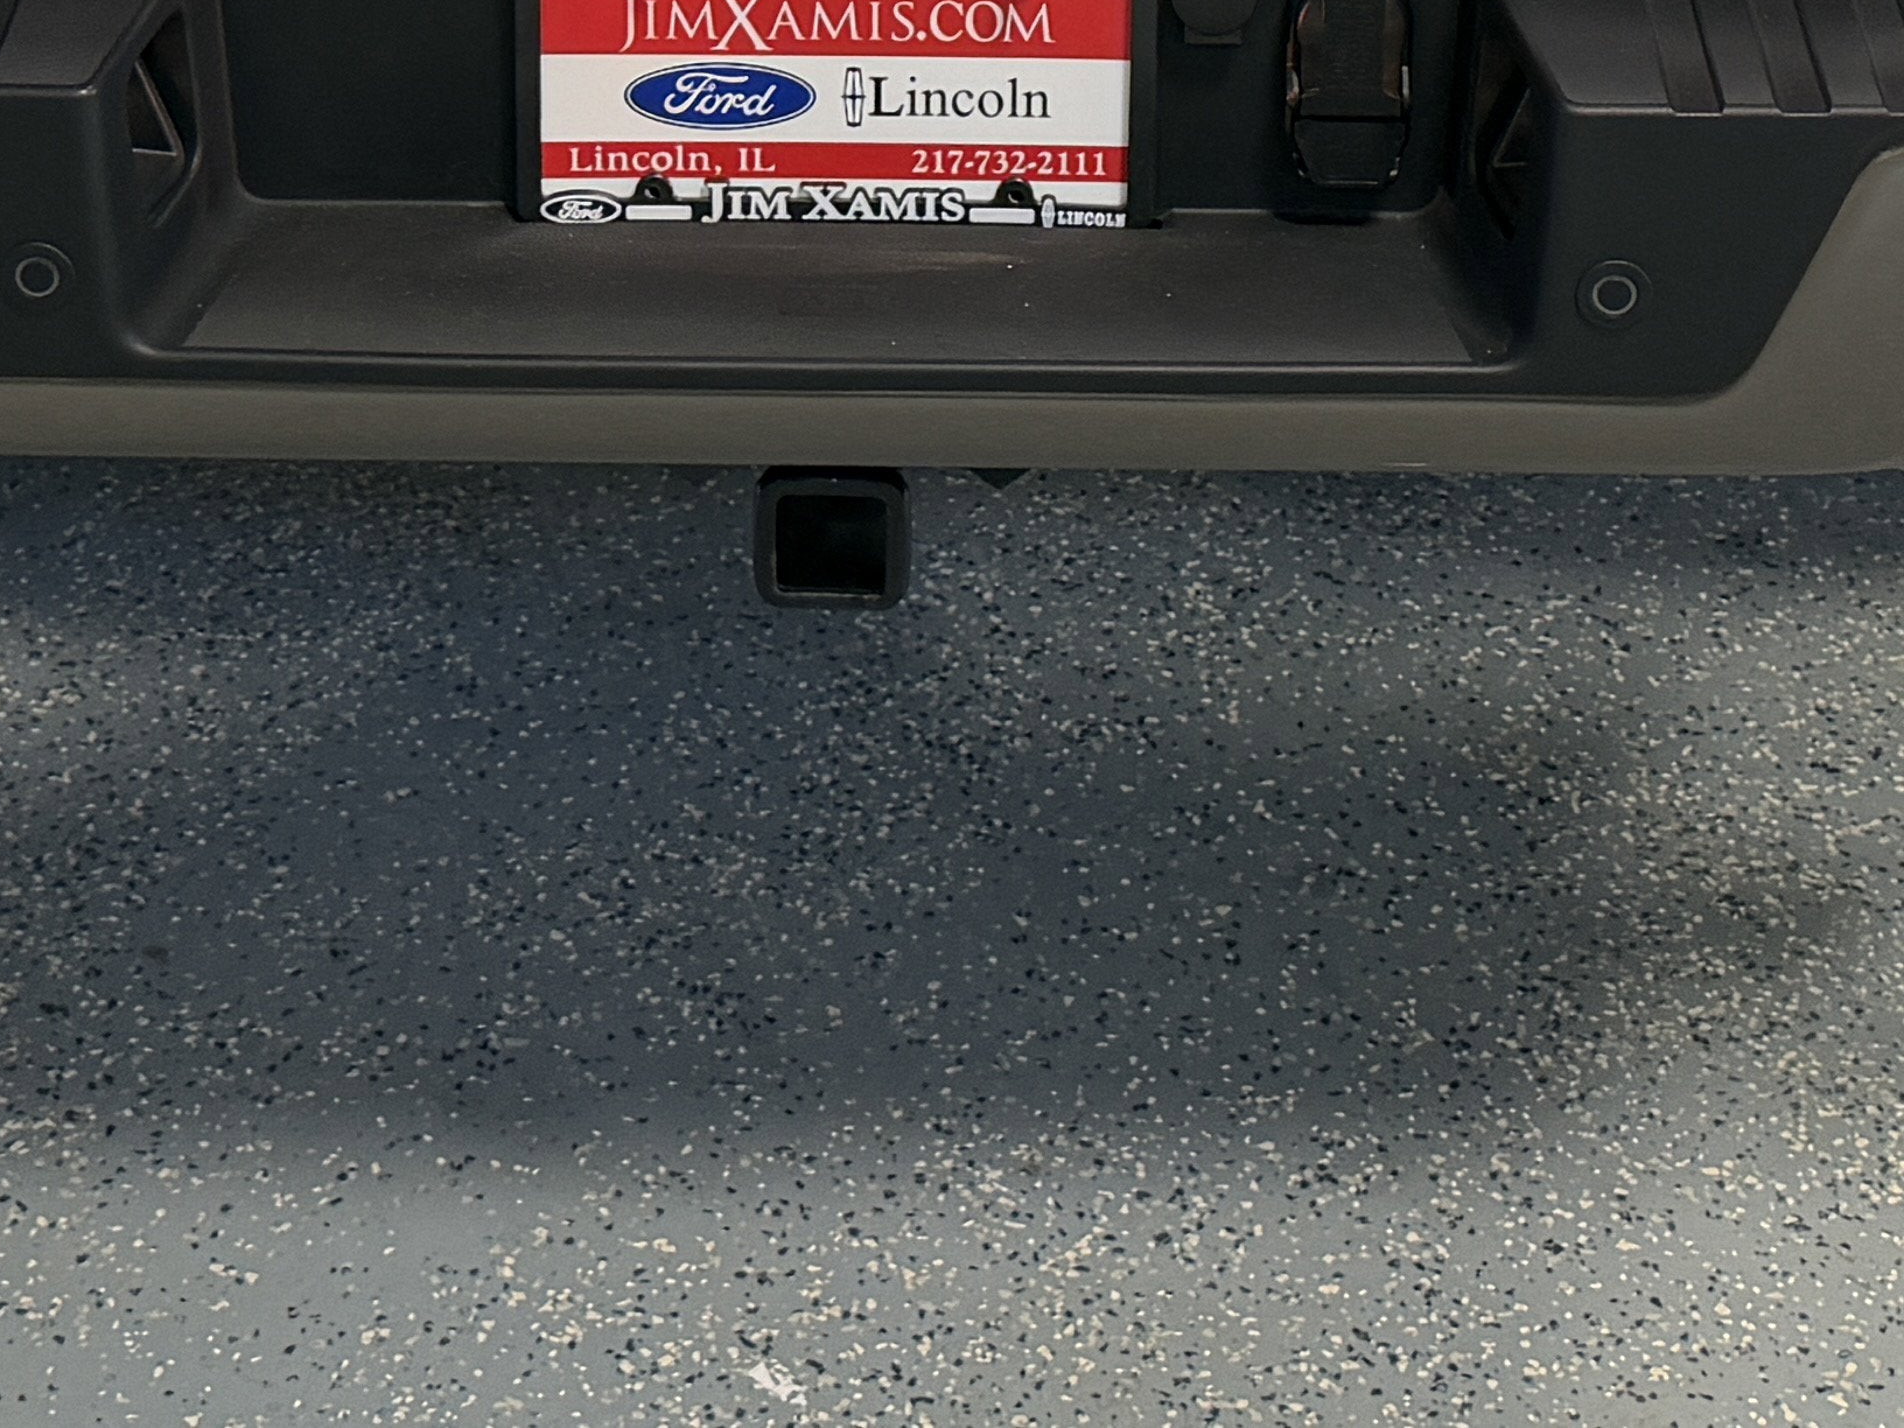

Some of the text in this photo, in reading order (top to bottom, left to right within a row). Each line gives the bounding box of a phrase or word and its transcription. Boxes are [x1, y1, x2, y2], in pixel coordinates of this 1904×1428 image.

[663, 70, 776, 117] Ford
[868, 76, 1051, 119] Lincoln
[569, 145, 777, 177] Lincoln, IL
[911, 148, 1107, 177] 217-732-2111
[557, 199, 604, 222] Ford
[701, 180, 966, 224] JIM XAMIS
[1057, 210, 1127, 228] LINCOLN
